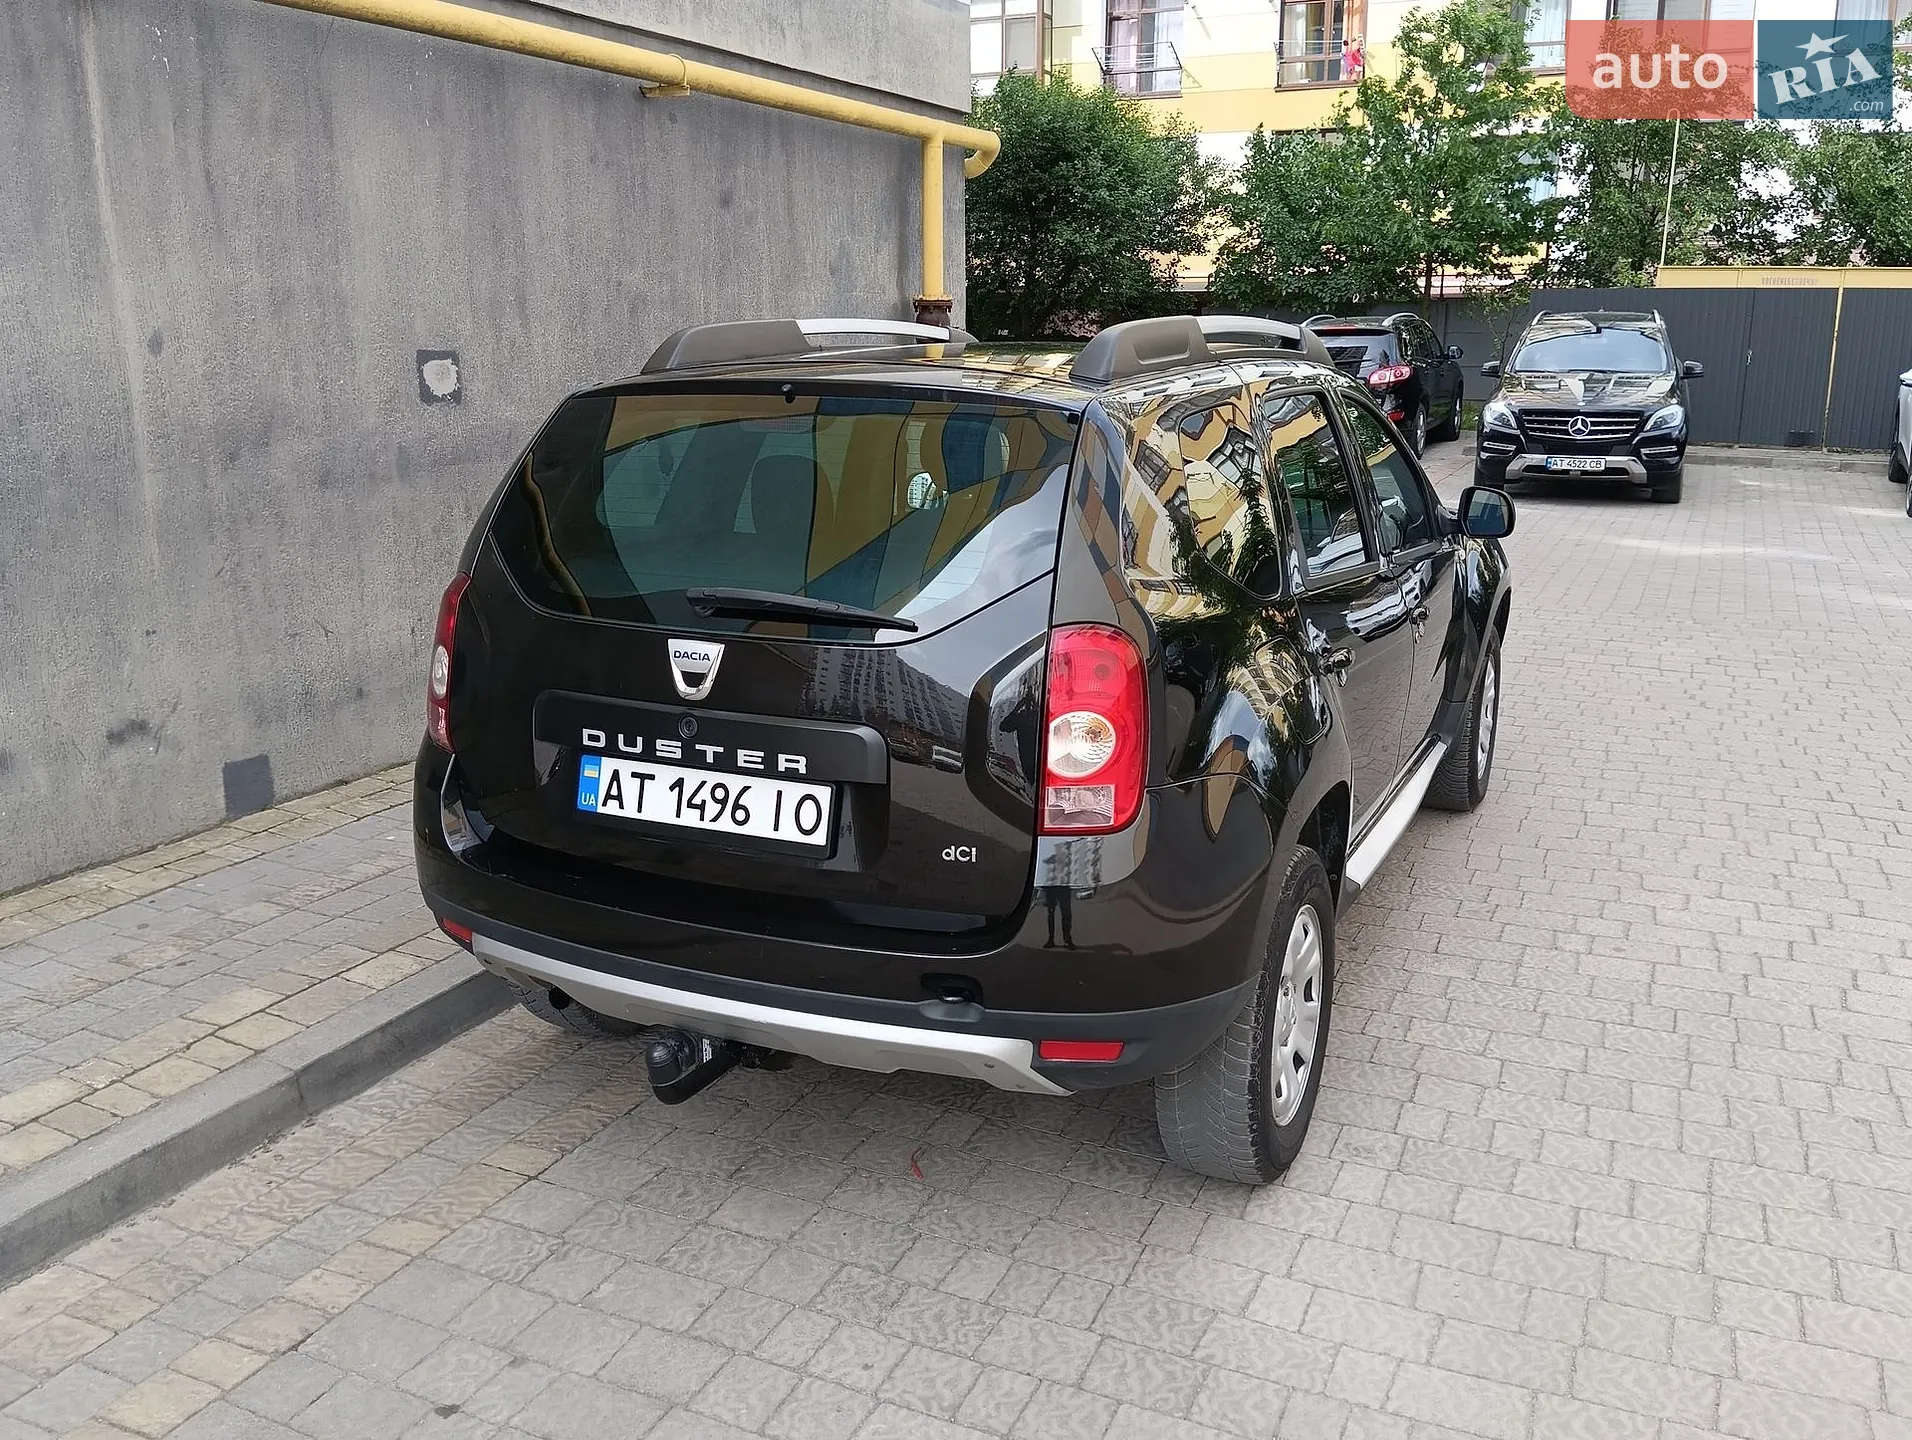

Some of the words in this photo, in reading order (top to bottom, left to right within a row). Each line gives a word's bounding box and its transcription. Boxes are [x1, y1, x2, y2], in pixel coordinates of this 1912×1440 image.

[1552, 459, 1565, 467] AT
[1566, 459, 1587, 468] 4522
[1589, 460, 1602, 468] CB
[673, 650, 711, 662] DACIA
[582, 728, 808, 775] DUSTER
[581, 792, 597, 807] UA
[602, 769, 656, 814] AT
[668, 777, 752, 827] 1496
[772, 789, 823, 836] IO
